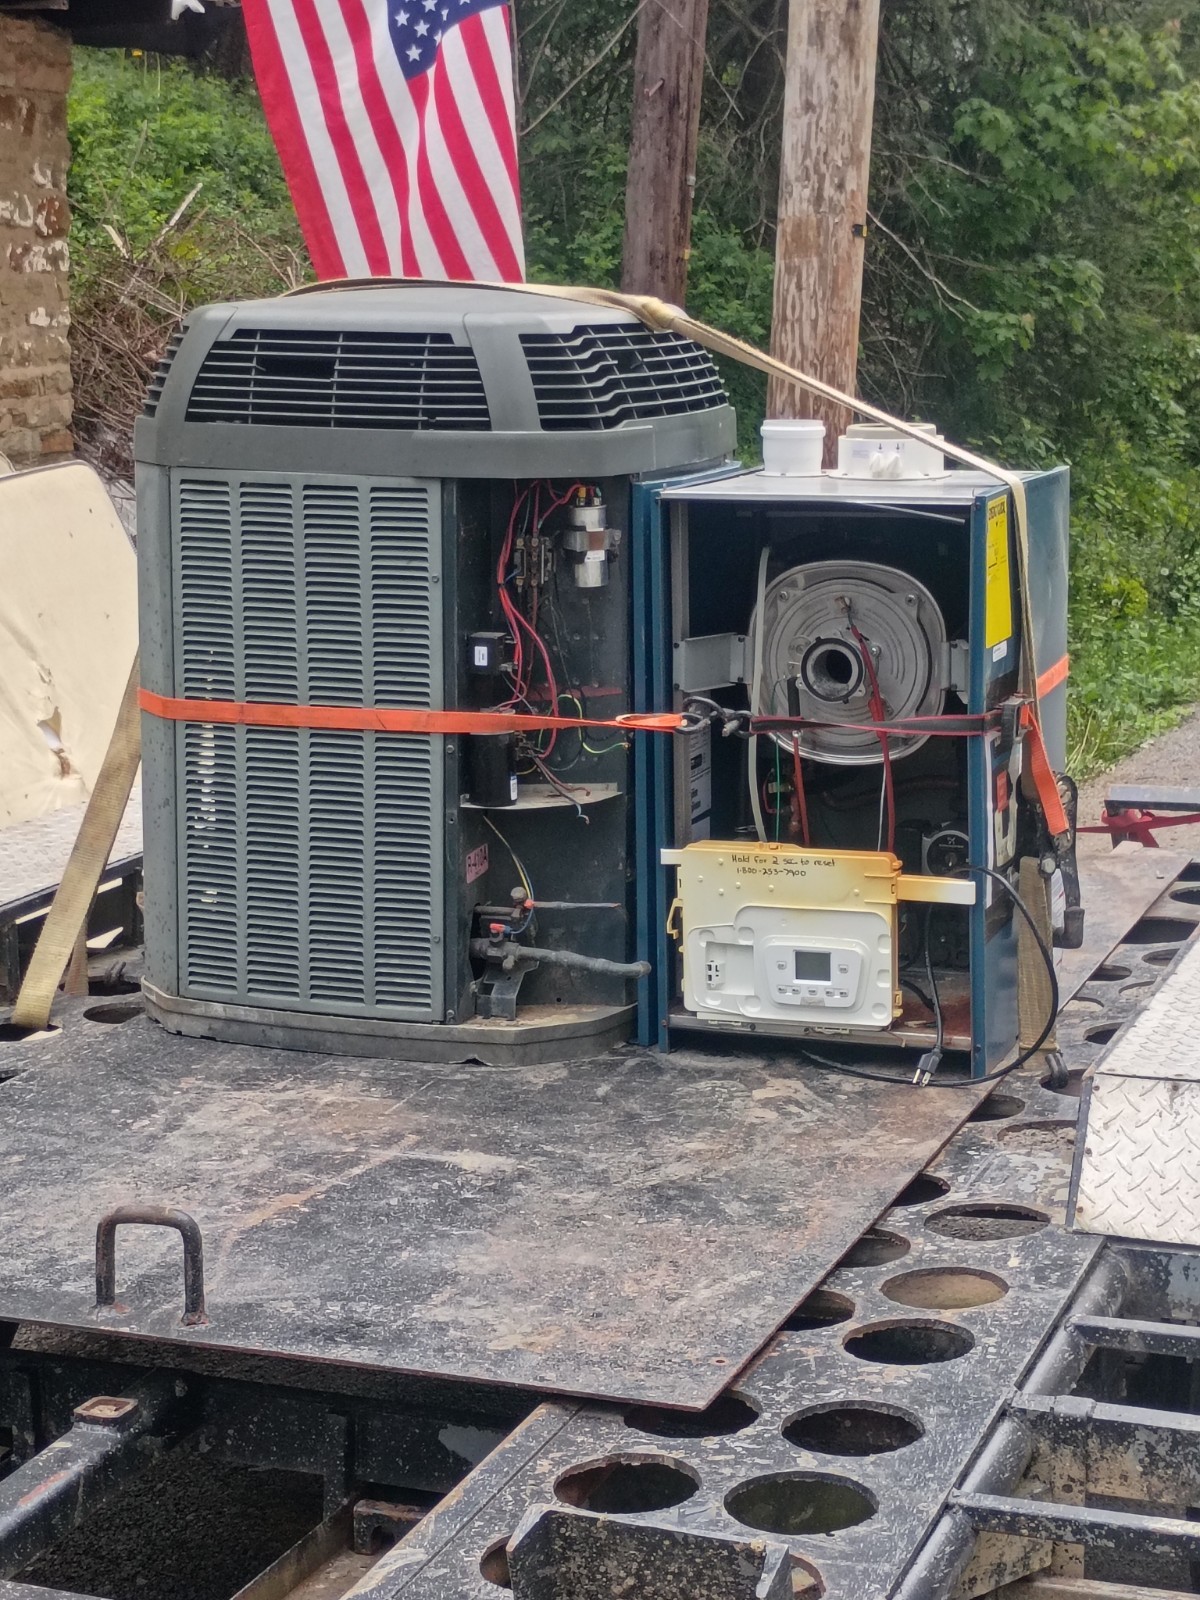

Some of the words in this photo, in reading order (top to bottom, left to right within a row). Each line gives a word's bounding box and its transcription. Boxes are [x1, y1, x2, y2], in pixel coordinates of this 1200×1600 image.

[732, 854, 750, 863] Hold
[754, 855, 767, 863] for
[772, 855, 779, 865] 2
[801, 857, 810, 866] to
[813, 858, 836, 867] reset
